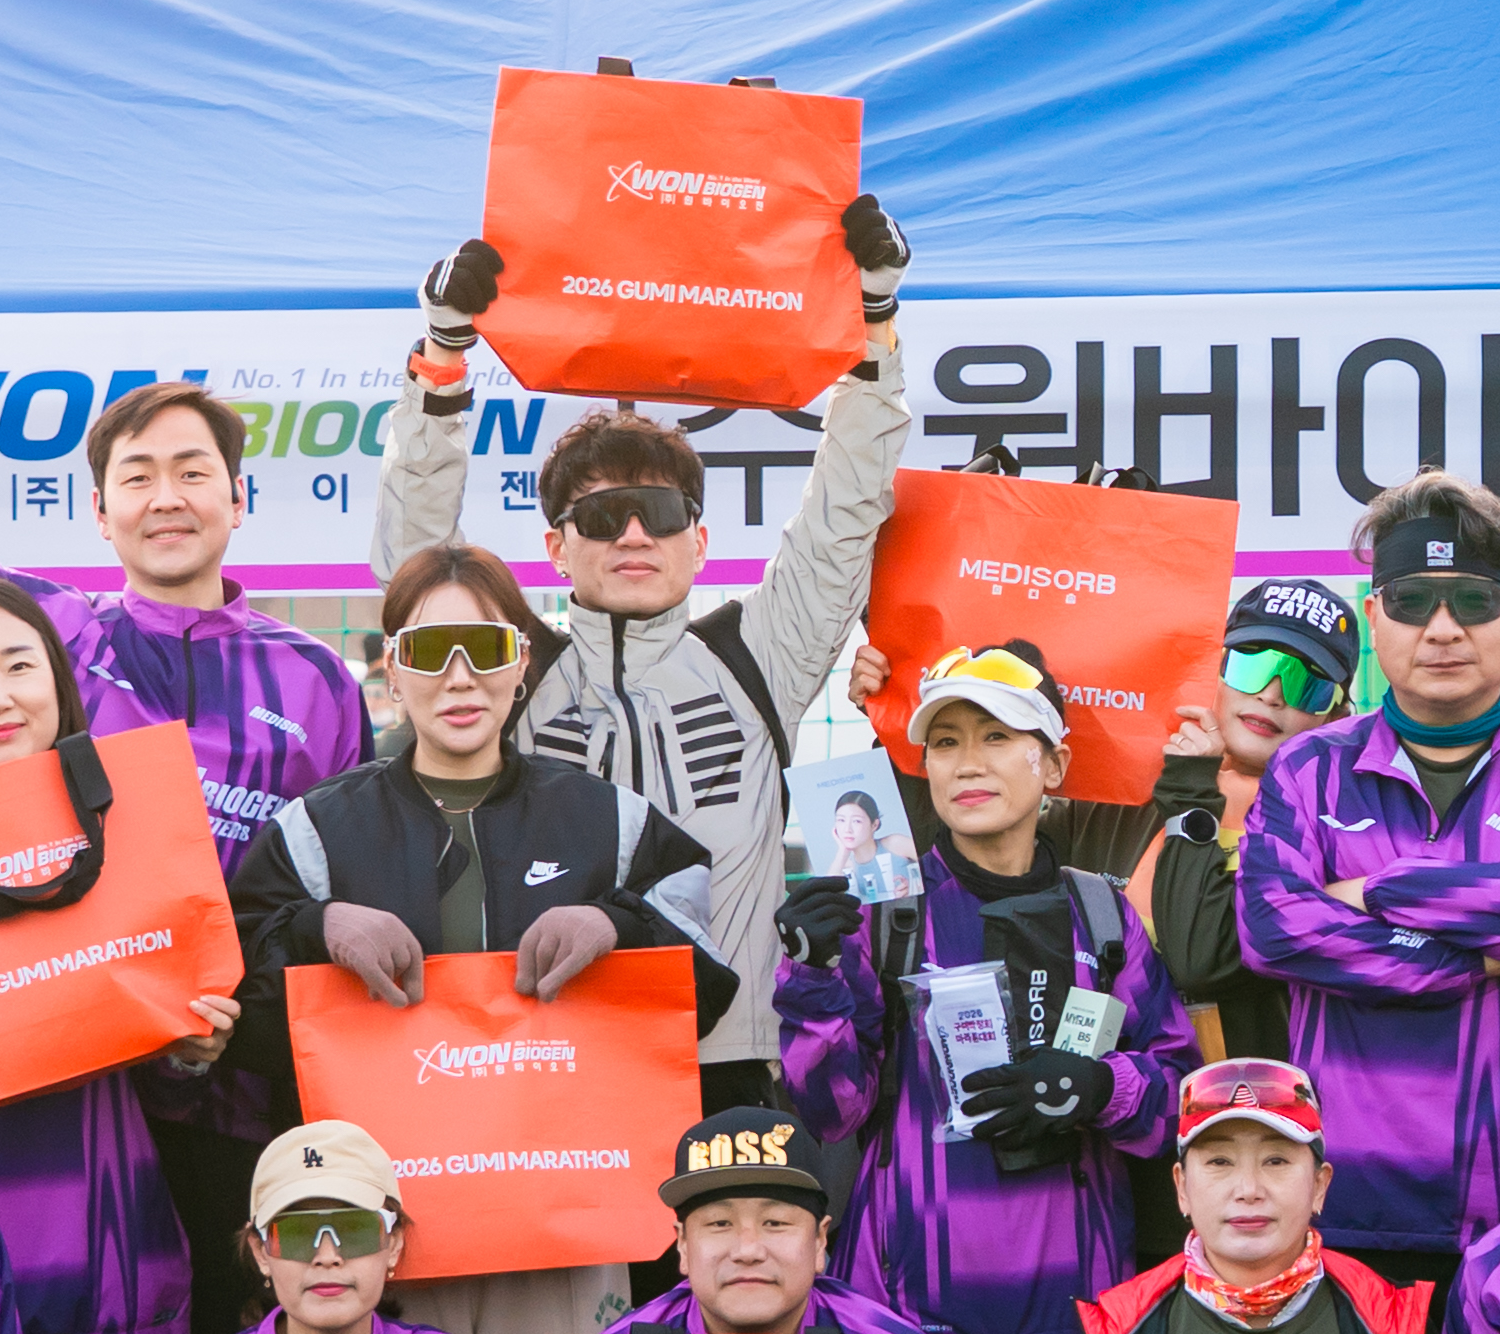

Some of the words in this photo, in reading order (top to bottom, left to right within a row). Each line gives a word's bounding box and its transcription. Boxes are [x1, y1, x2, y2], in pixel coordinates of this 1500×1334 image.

[632, 169, 704, 193] WON
[702, 177, 767, 200] BIOGEN
[562, 275, 614, 297] 2026
[616, 280, 676, 303] GUMI
[678, 285, 803, 311] MARATHON
[321, 369, 346, 388] In
[959, 557, 1116, 595] MEDISORB
[1264, 583, 1344, 621] PEARLY
[1265, 598, 1334, 634] GATES
[1058, 683, 1144, 711] RATHON
[36, 839, 95, 866] BIOGE
[530, 861, 559, 875] NIKE
[53, 929, 173, 969] MARATHON
[958, 1009, 983, 1020] 2026
[439, 1042, 512, 1066] WON
[511, 1046, 575, 1062] BIOGEN
[445, 1152, 506, 1175] GUMI
[507, 1149, 630, 1171] MARATHON
[689, 1128, 789, 1172] BOSS
